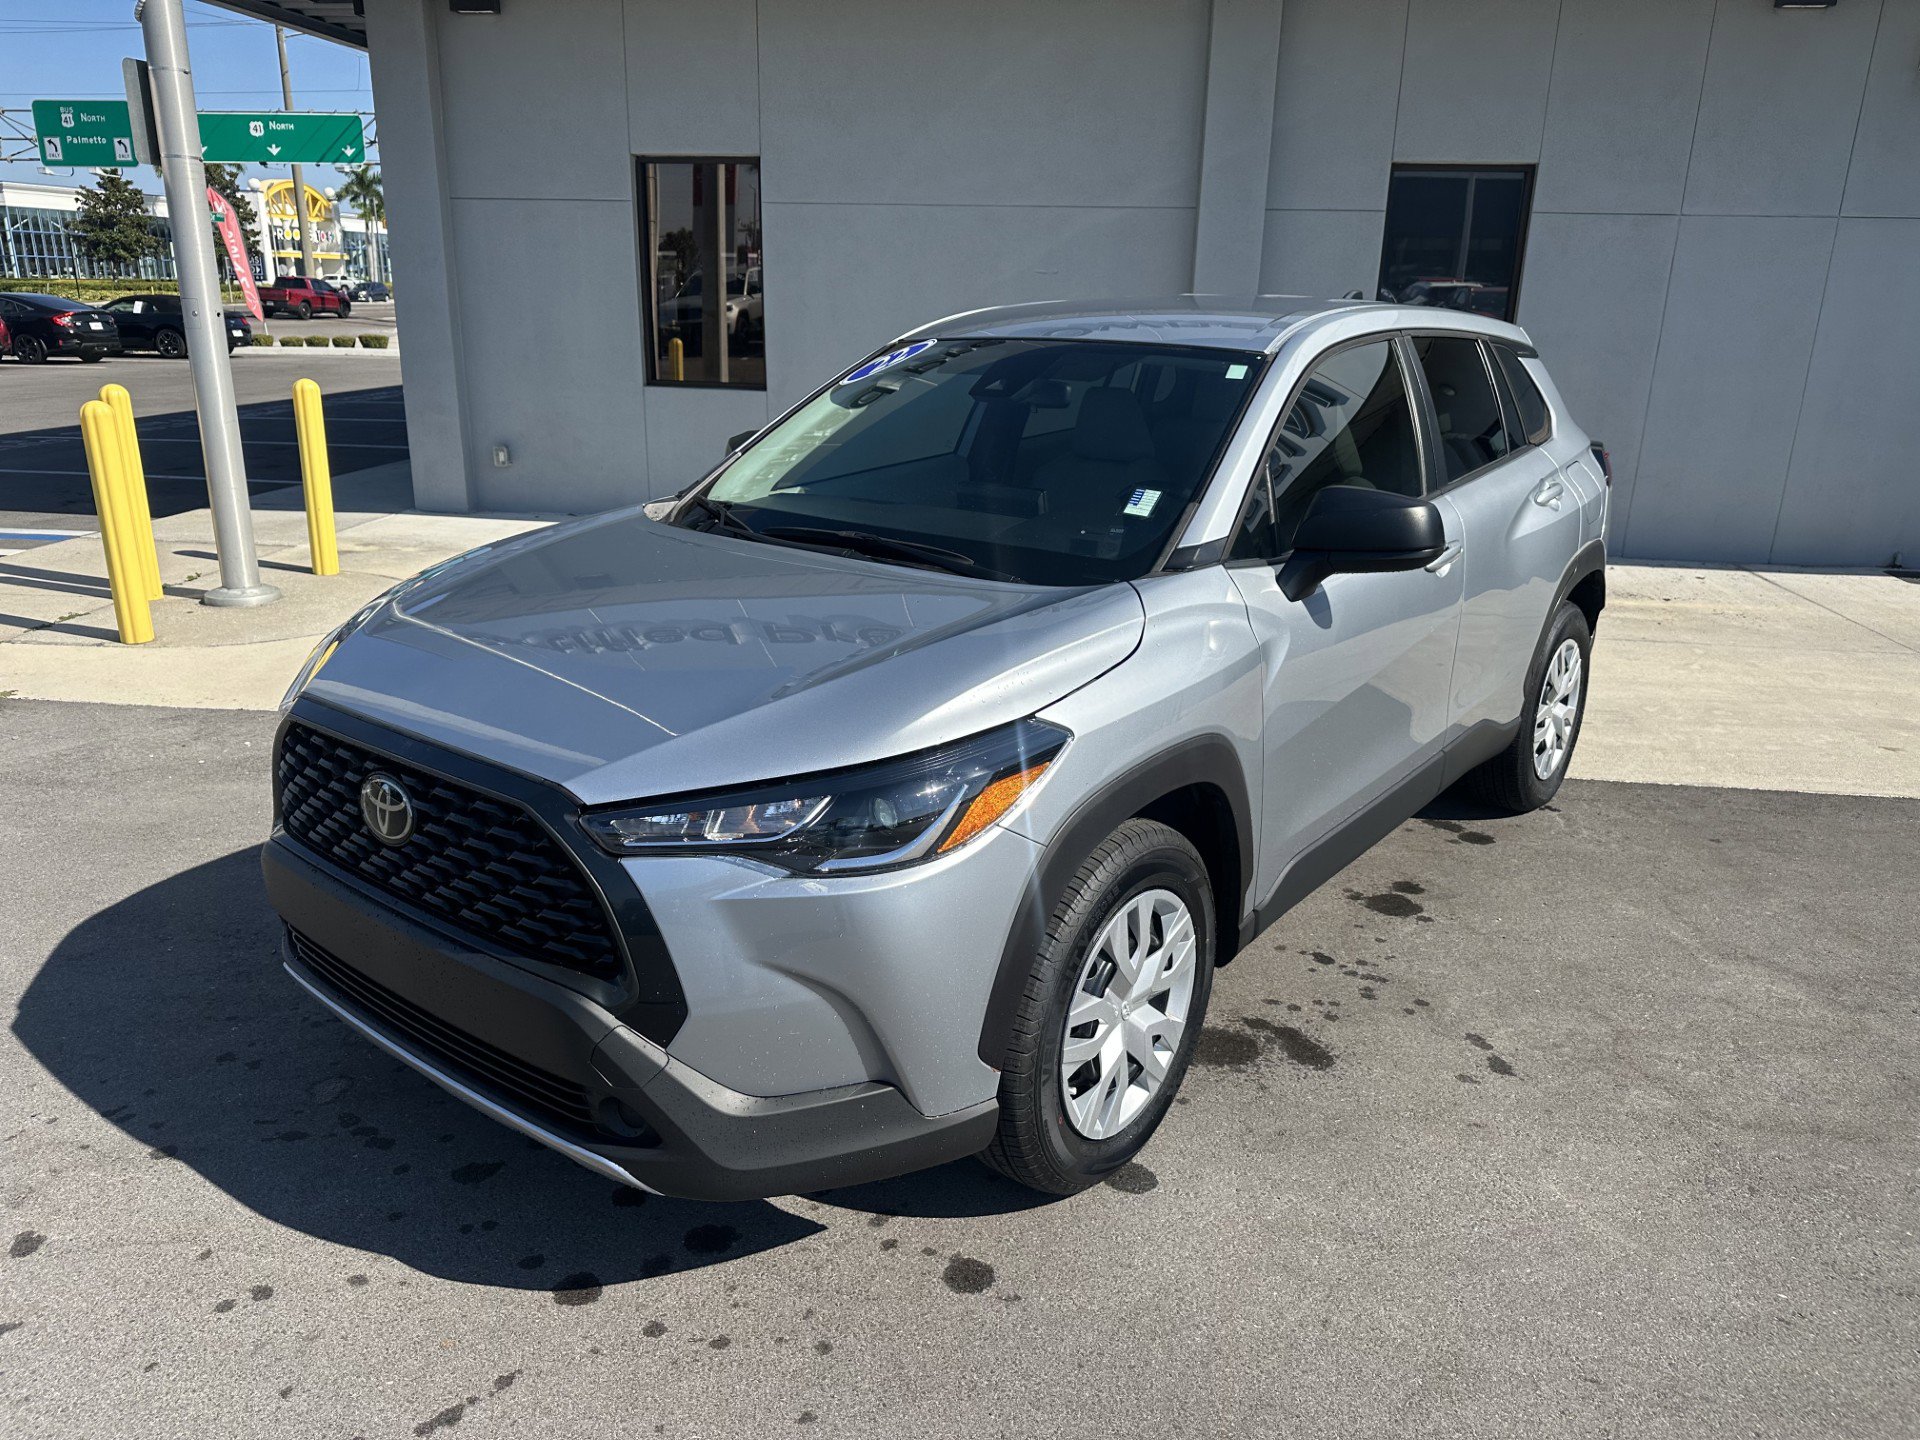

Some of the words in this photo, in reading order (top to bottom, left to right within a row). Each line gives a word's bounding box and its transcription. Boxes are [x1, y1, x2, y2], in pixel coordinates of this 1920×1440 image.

[60, 106, 74, 114] BUS
[63, 115, 72, 125] 41
[252, 124, 262, 133] 41
[66, 135, 107, 145] Palmetto
[868, 347, 911, 376] 22
